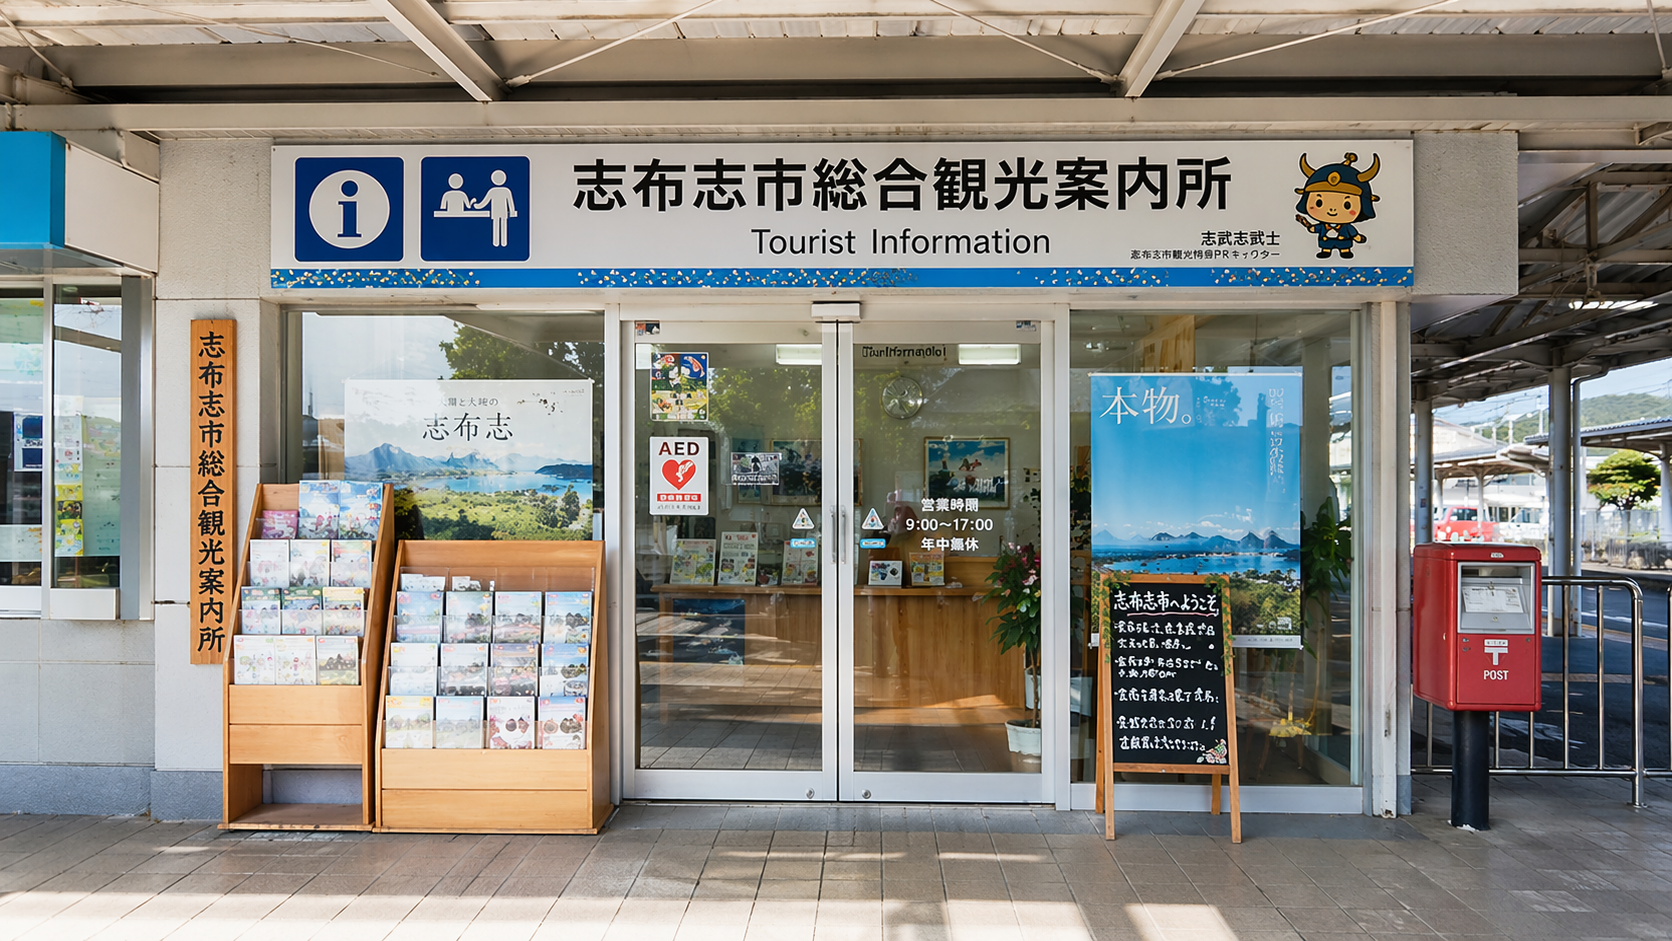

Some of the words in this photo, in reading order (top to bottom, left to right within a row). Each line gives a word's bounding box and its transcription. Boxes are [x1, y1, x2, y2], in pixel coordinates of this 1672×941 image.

[573, 157, 1231, 211] 志布志市総合観光案内所
[751, 229, 856, 254] Tourist
[872, 228, 1050, 254] Information
[1100, 386, 1192, 425] 本物。
[422, 412, 513, 442] 志布志
[658, 441, 700, 456] AED
[197, 331, 226, 653] 志布志市総合観光案内所
[1483, 669, 1509, 681] POST
